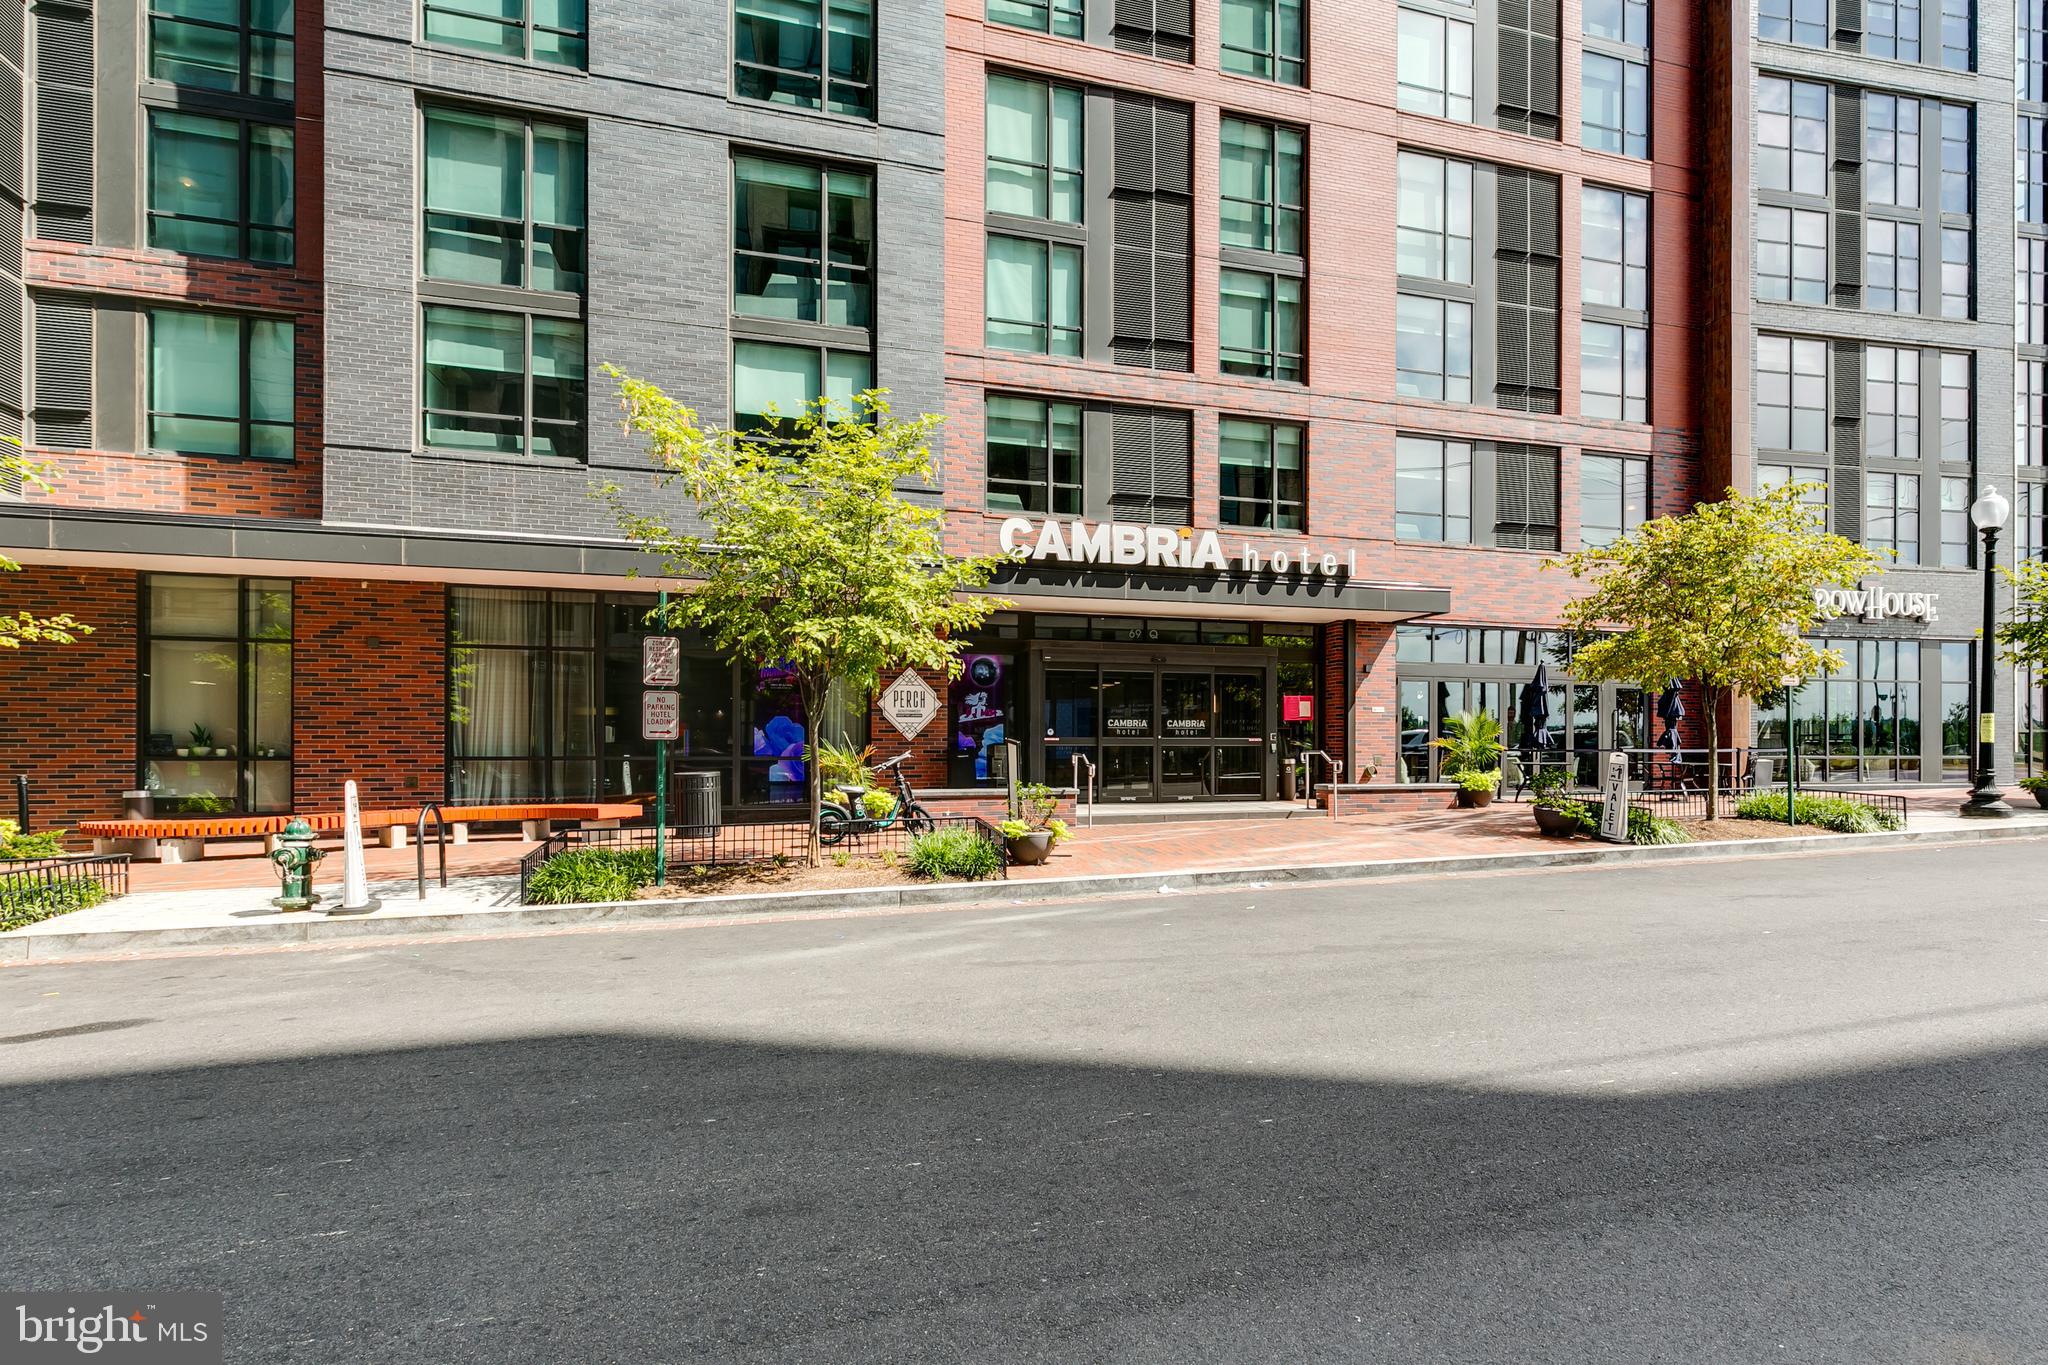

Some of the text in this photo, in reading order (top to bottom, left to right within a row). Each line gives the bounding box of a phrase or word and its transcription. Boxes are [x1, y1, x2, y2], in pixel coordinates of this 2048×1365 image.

[1241, 542, 1356, 577] hotel
[1129, 629, 1159, 639] 69 Q
[893, 690, 926, 709] PERCH
[1116, 728, 1140, 736] hotel
[1608, 783, 1619, 832] VALET
